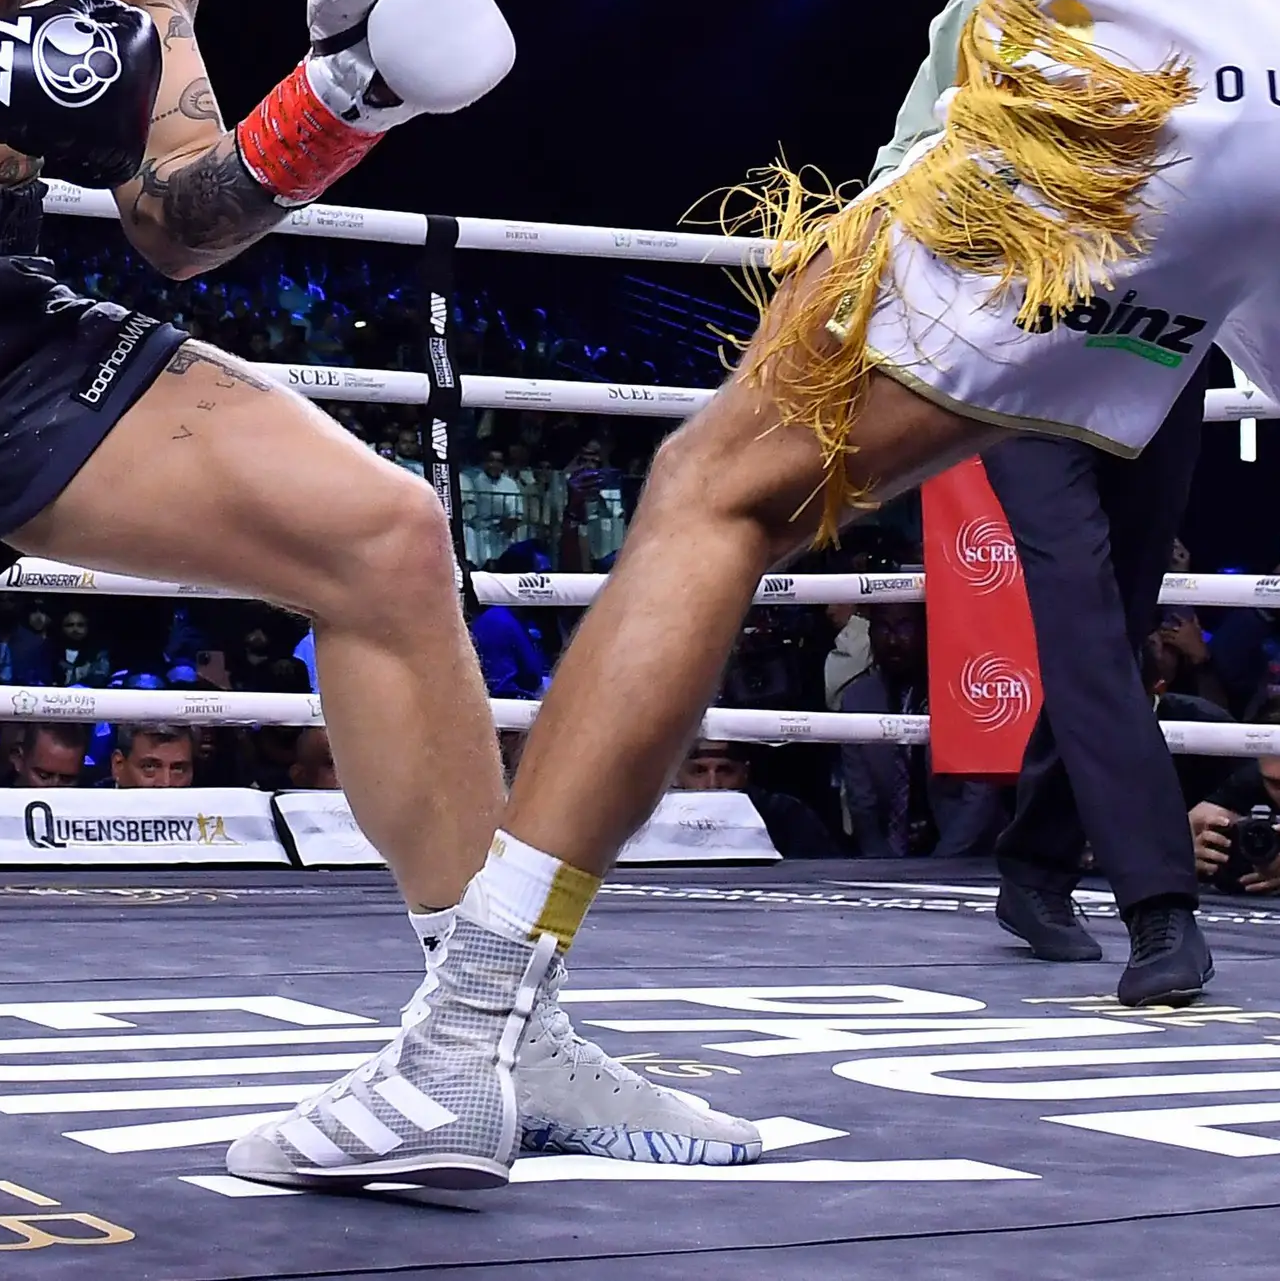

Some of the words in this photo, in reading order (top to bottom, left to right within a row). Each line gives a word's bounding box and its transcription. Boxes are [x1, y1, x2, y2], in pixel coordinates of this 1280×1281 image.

[288, 369, 339, 387] SCEE
[608, 388, 654, 401] SCEE
[965, 544, 1016, 563] SCEE
[6, 563, 81, 588] QUEENSBERRY
[24, 801, 194, 849] QUEENSBERRY
